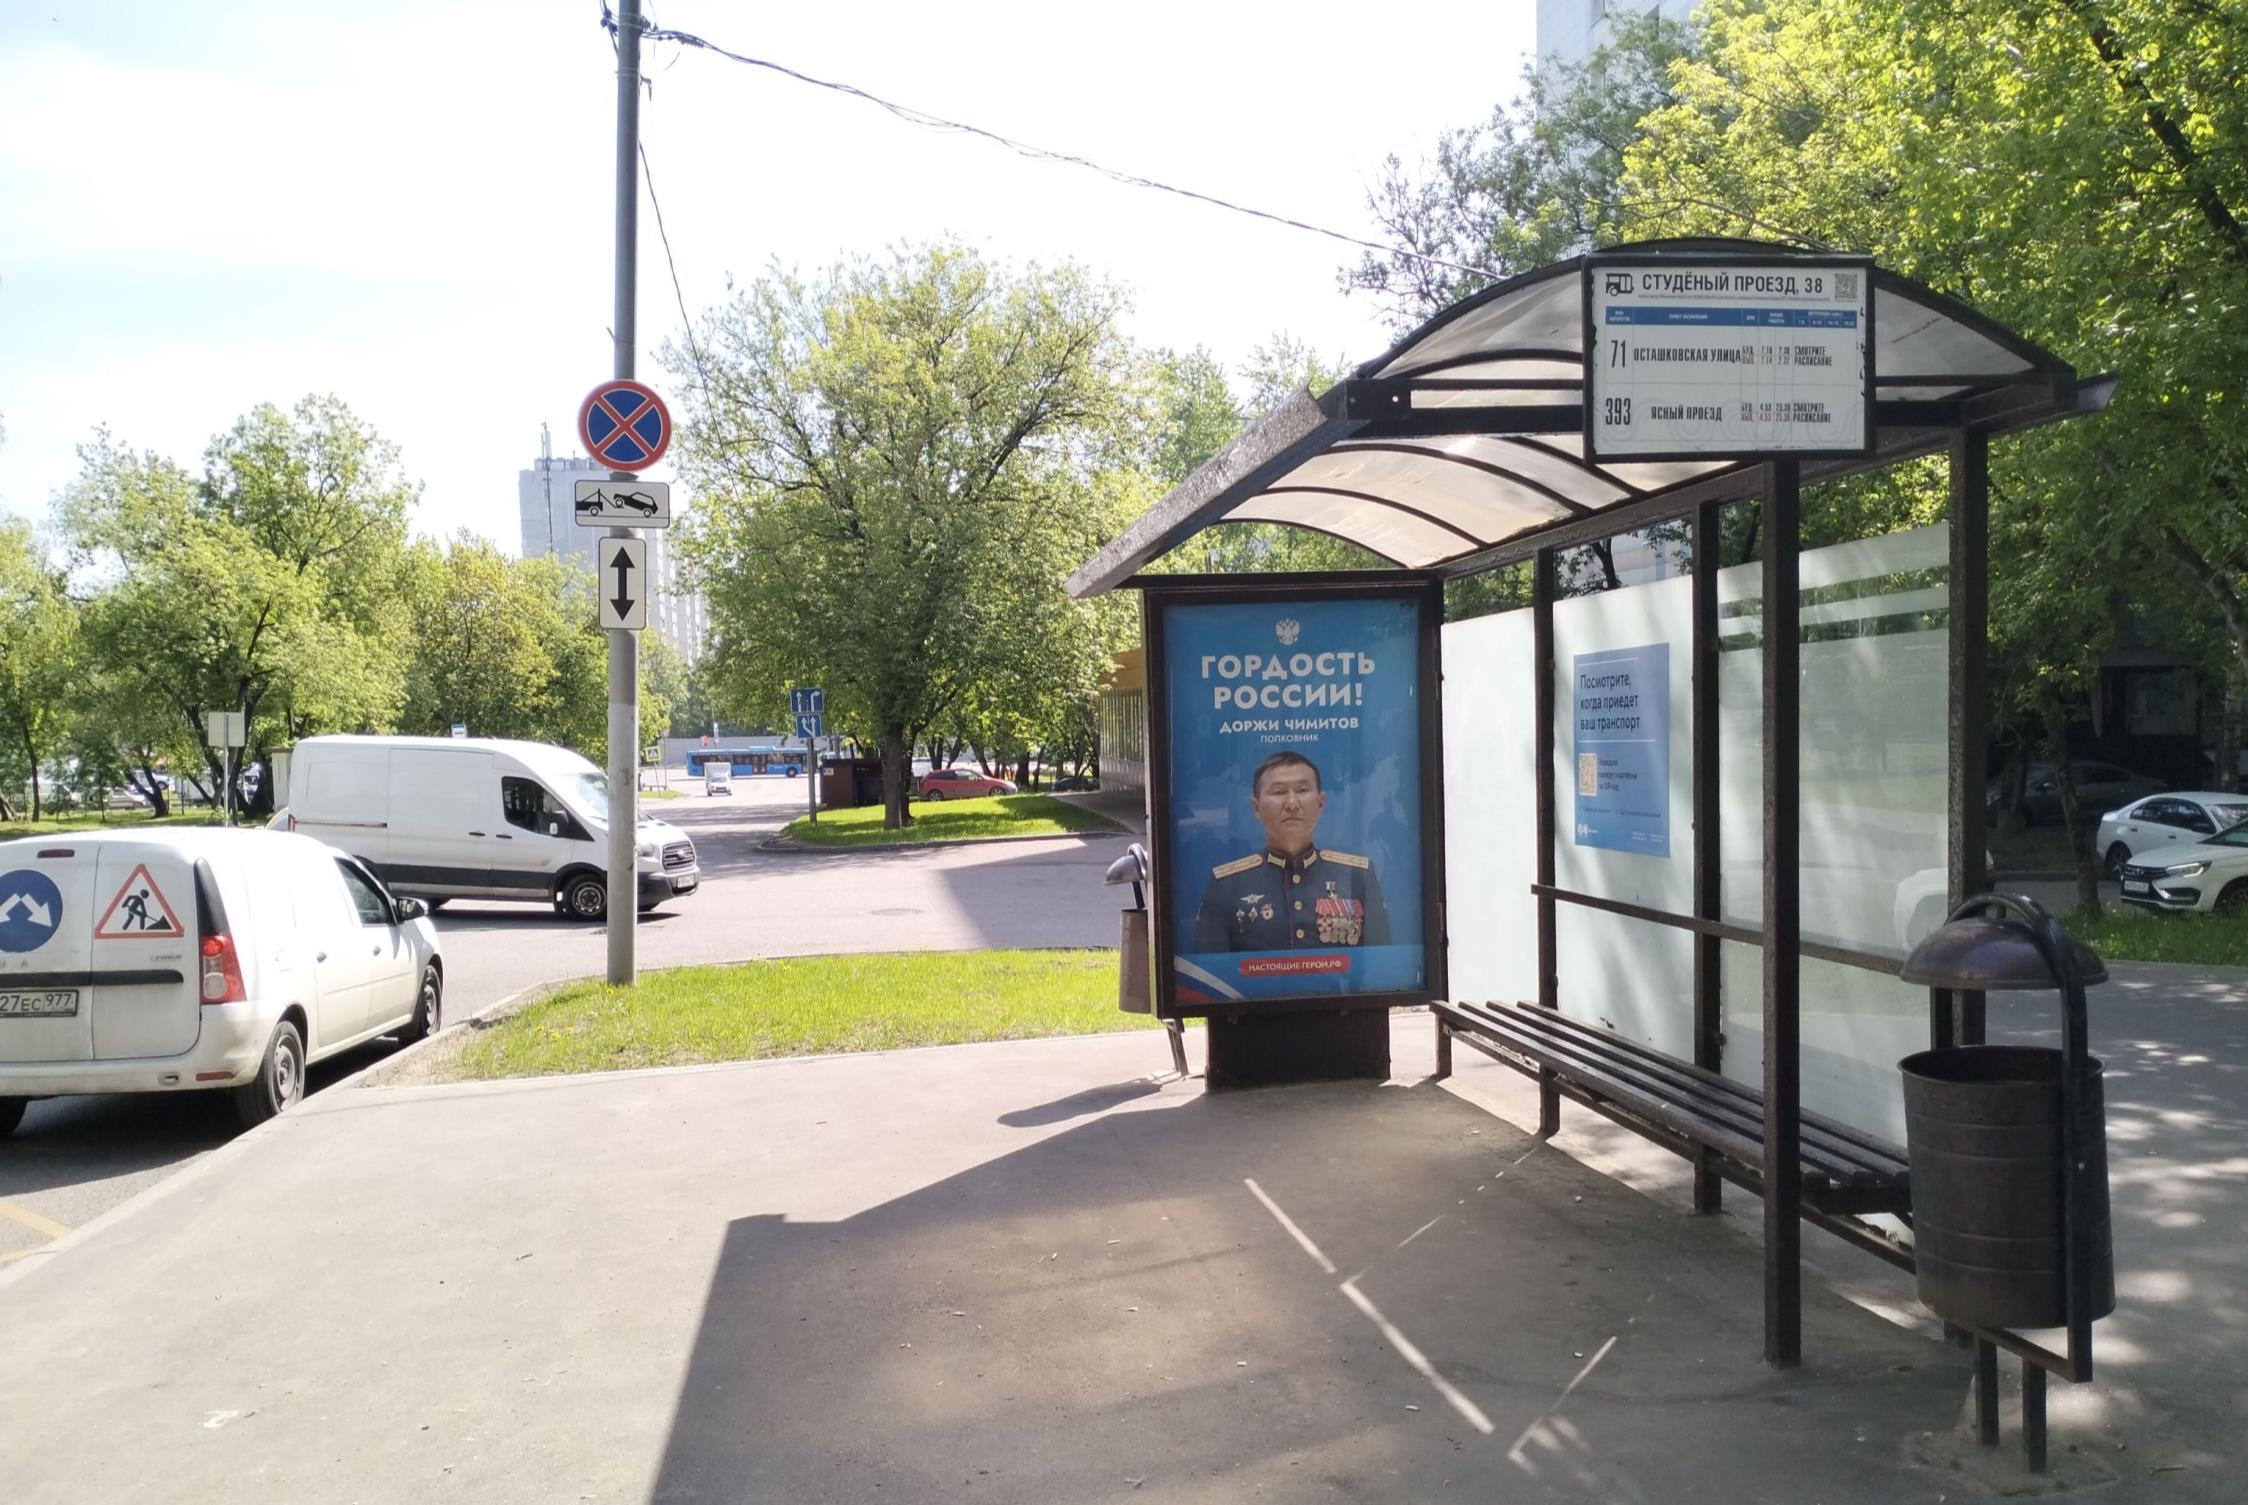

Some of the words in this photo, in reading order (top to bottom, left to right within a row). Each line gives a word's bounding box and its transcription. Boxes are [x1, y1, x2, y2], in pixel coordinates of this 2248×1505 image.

[1642, 271, 1729, 293] СТУДЁНЫЙ
[1734, 275, 1799, 295] ПРОЕЗД,
[1804, 277, 1823, 293] 38
[1610, 339, 1626, 368] 71
[1633, 347, 1708, 362] ОСТАШКОВСКАЯ
[1710, 348, 1741, 364] УЛИЦА
[1794, 355, 1832, 367] РАСПИСАНИЕ
[1605, 397, 1631, 426] 393
[1651, 404, 1684, 420] ЯСНЫЙ
[1686, 406, 1722, 422] ПРОЕЗД
[1793, 412, 1831, 424] РАСПИСАНИЕ
[1201, 652, 1376, 681] ГОРДОСТЬ
[1580, 674, 1632, 691] Посмотрите,
[1214, 683, 1363, 710] РОССИИ!
[1580, 697, 1602, 712] когда
[1603, 694, 1639, 712] приедет
[1219, 719, 1280, 735] ДОРЖИ
[1285, 717, 1359, 732] ЧИМИТОВ
[1580, 719, 1596, 730] ваш
[1597, 716, 1640, 733] транспорт
[1260, 733, 1320, 744] ПОЛКОВНИК
[46, 993, 72, 1007] 977
